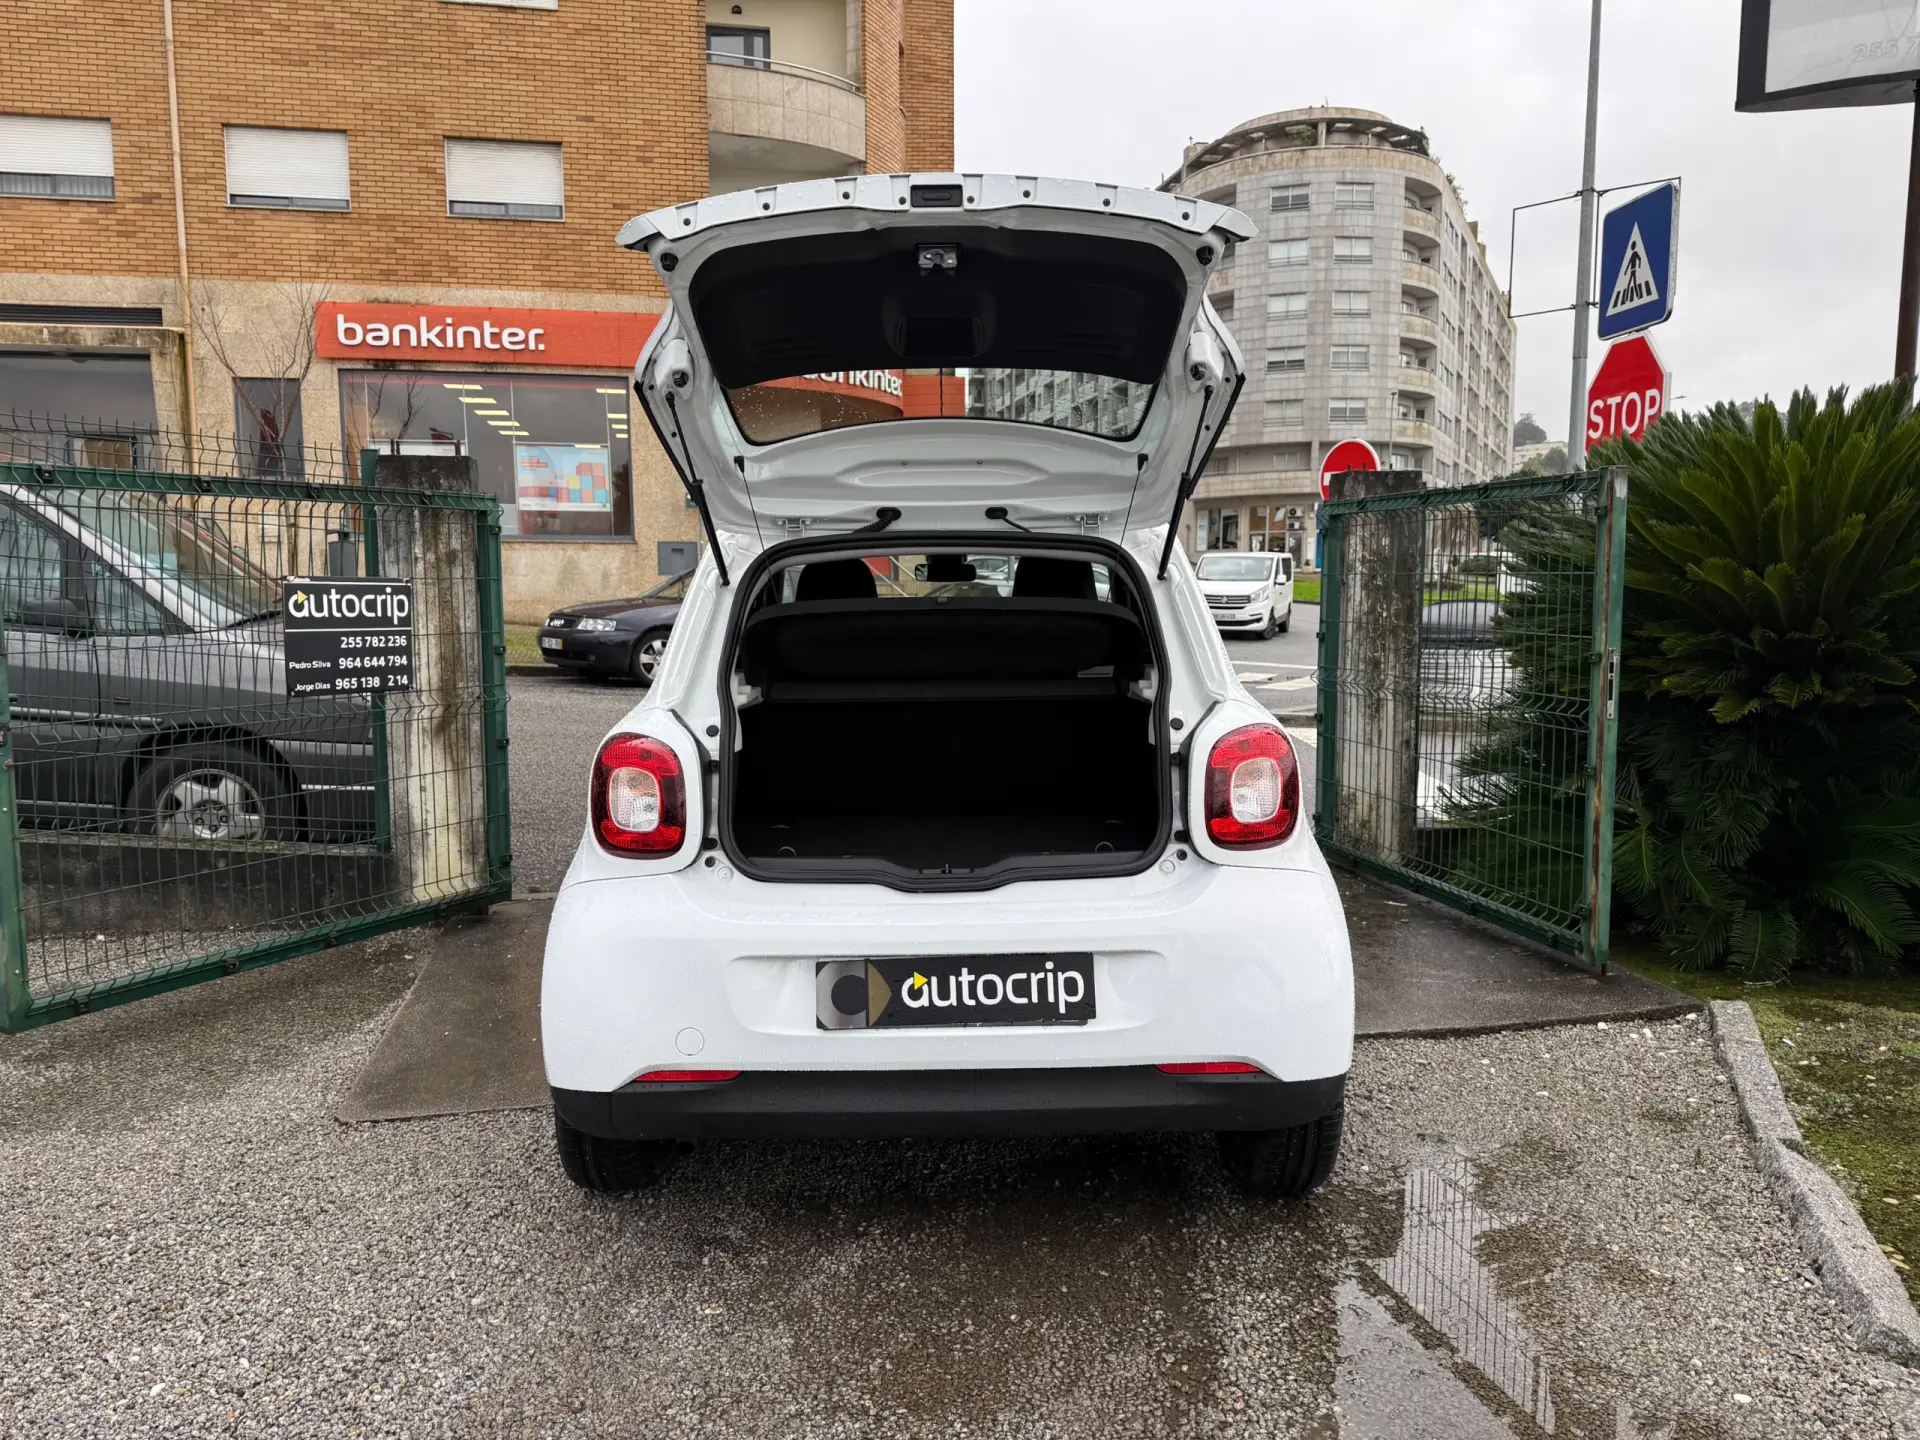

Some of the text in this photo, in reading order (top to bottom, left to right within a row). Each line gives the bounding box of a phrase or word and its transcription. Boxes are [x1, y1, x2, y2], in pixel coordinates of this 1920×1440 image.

[1588, 388, 1661, 439] STOP
[288, 586, 409, 625] autocrip
[340, 635, 407, 648] 255 782 236
[289, 655, 408, 669] Pedro Silva 964 644 794
[294, 675, 409, 692] Jorge Dias 965 138 214
[901, 961, 1085, 1014] autocrip
